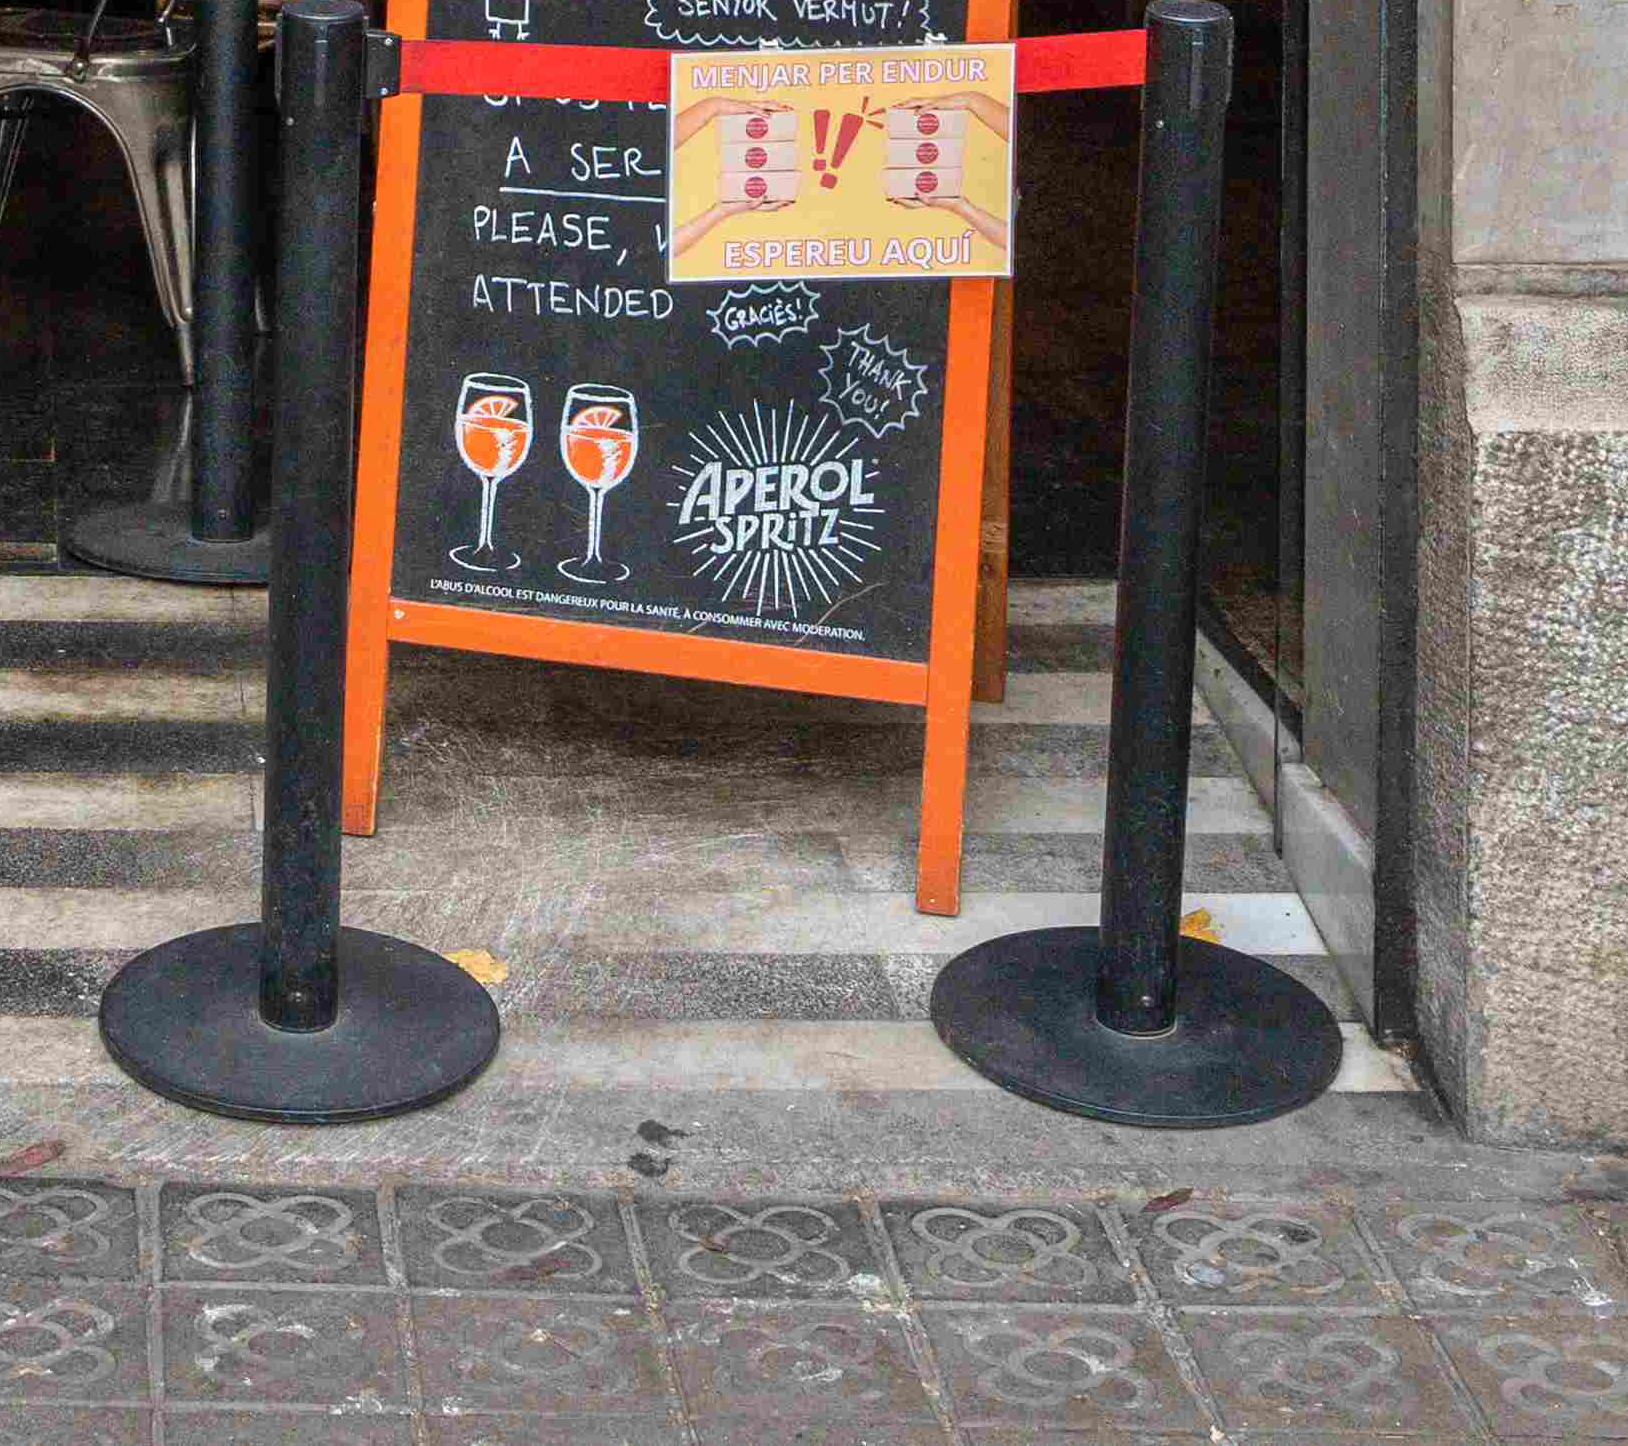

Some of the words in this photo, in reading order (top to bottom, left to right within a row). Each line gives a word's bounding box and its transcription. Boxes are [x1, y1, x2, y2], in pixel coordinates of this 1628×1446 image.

[691, 61, 811, 92] MENJAR
[818, 59, 874, 87] PER
[882, 56, 988, 85] ENDUR
[504, 136, 531, 180] A
[570, 143, 664, 181] SER
[473, 206, 630, 267] PLEASE,
[724, 237, 873, 270] ESPEREU
[881, 228, 976, 267] AQUÍ
[472, 273, 674, 319] ATTENDED
[847, 340, 913, 402] THANK
[678, 457, 876, 526] APEROL
[535, 588, 599, 609] DANGEREUX
[599, 595, 629, 613] POUR
[693, 609, 763, 629] CONSOMMER
[763, 617, 791, 633] AVEC
